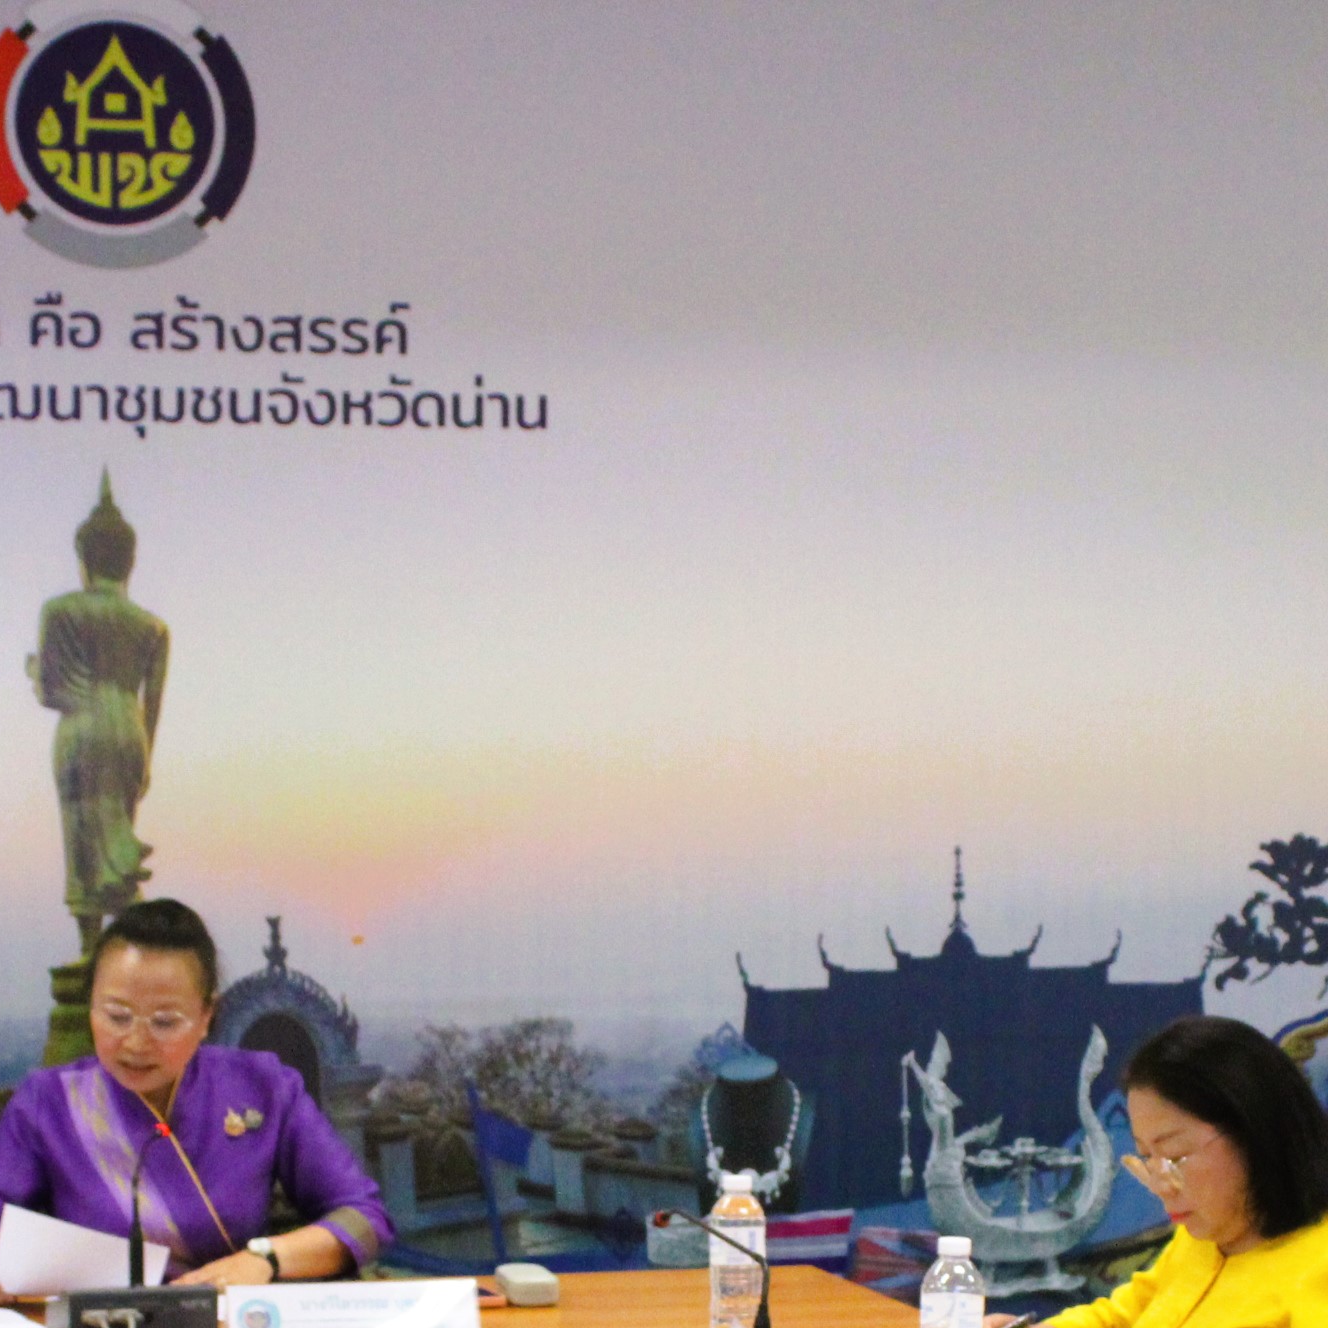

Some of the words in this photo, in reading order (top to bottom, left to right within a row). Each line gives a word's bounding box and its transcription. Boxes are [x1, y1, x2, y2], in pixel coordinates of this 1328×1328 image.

[29, 291, 103, 350] คือ
[129, 294, 411, 356] สร้างสรรค์
